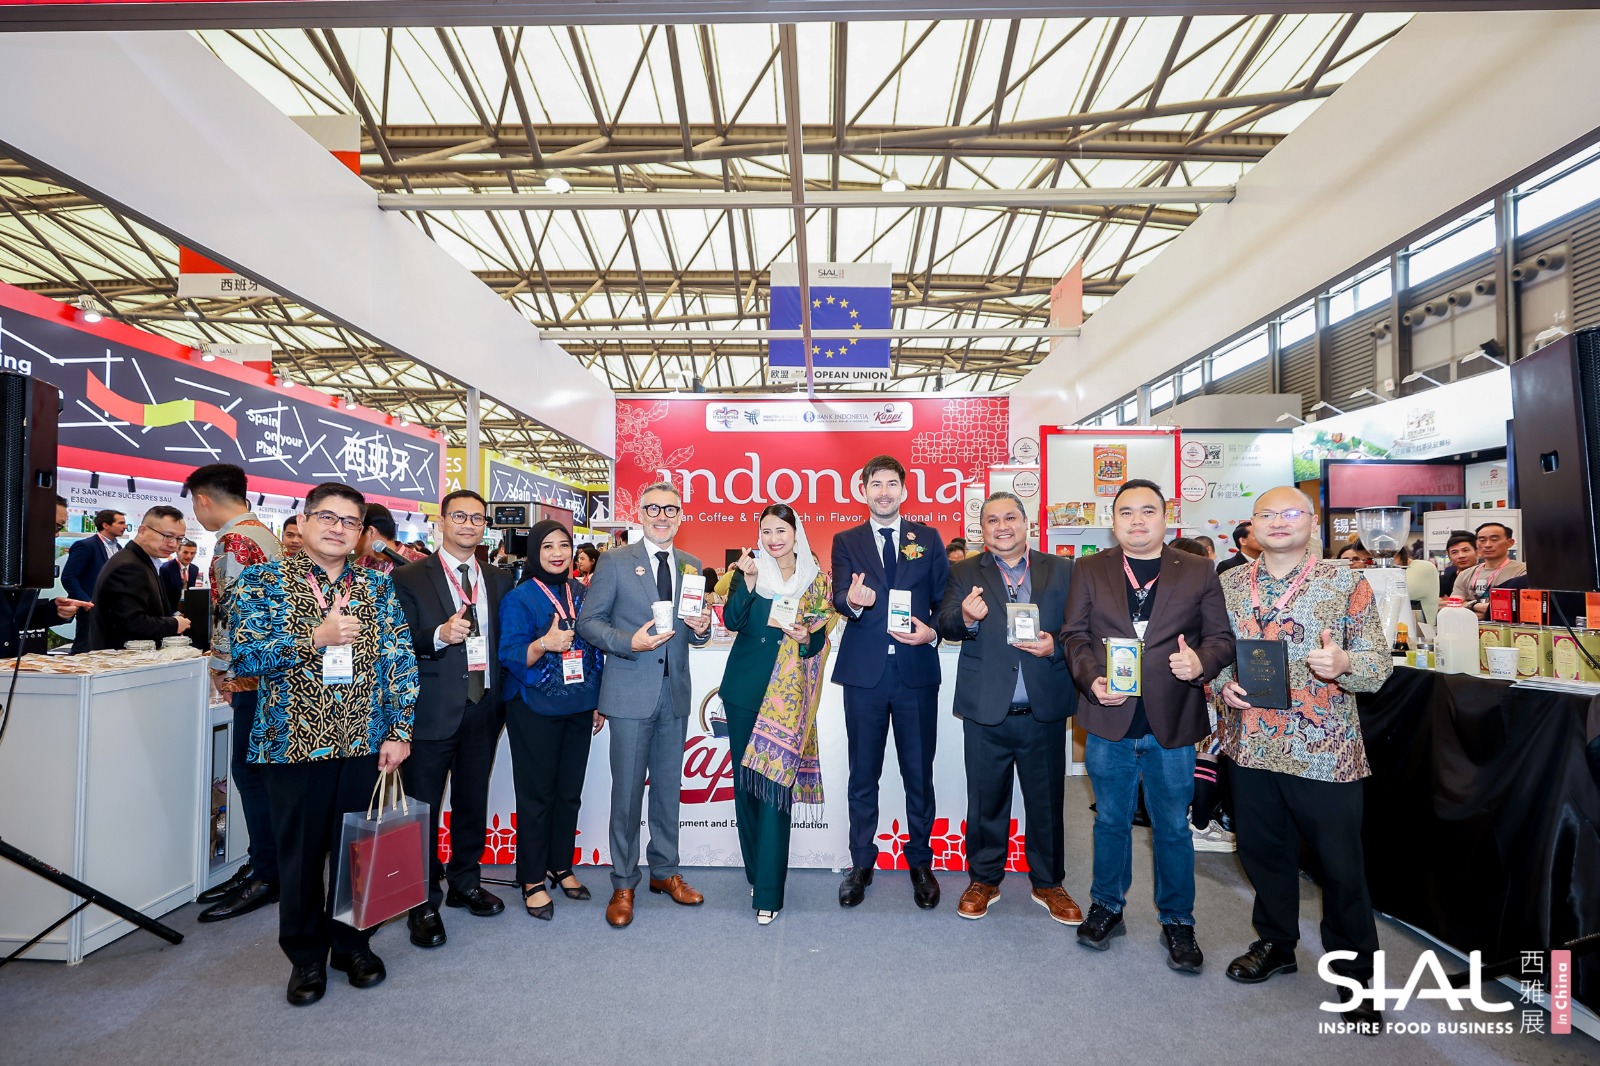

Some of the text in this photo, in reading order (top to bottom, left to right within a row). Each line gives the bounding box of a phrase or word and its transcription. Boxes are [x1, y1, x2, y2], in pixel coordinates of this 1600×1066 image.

[817, 269, 839, 277] SIAL
[221, 278, 258, 292] 西班牙
[770, 370, 789, 379] 欧盟
[804, 370, 888, 380] OPEAN UNION
[247, 408, 279, 426] Spain
[874, 410, 904, 424] Kappi
[264, 430, 303, 448] on your
[256, 440, 283, 457] Plate
[343, 434, 411, 482] 西班牙
[657, 452, 976, 505] ndoneia
[71, 487, 80, 495] FJ
[82, 488, 116, 498] SANCHEZ
[118, 492, 158, 502] SUCESORES
[1208, 482, 1217, 499] 7
[70, 496, 97, 504] E3E009
[699, 512, 735, 522] Coffee
[739, 513, 748, 522] &
[815, 512, 825, 522] in
[830, 512, 866, 523] Flavor,
[901, 512, 932, 522] tional
[937, 512, 948, 522] in
[711, 819, 727, 828] and
[790, 820, 829, 829] undation
